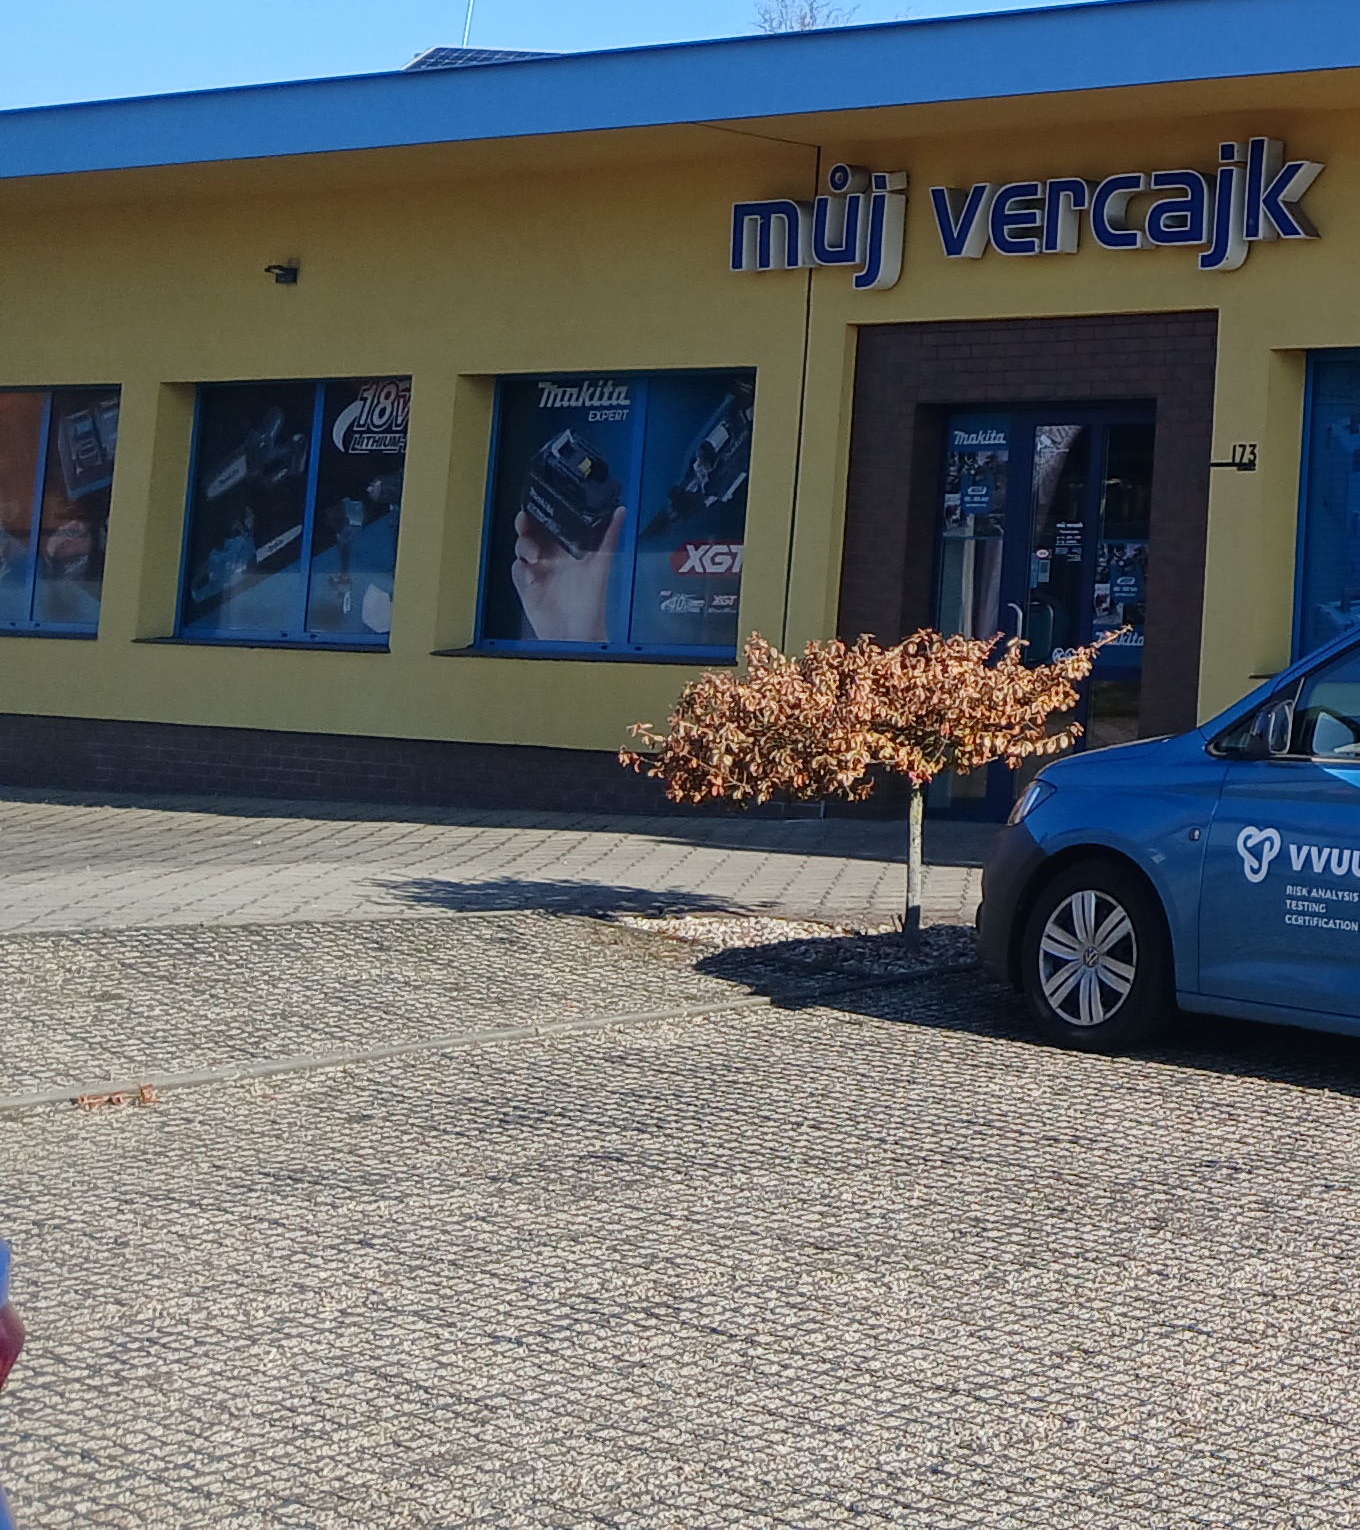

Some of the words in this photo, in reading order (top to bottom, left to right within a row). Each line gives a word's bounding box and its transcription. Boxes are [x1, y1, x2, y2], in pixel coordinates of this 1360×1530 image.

[730, 163, 908, 290] můj
[930, 137, 1324, 270] vercajk
[588, 410, 629, 421] EXPERT
[1232, 444, 1257, 463] 173
[679, 545, 744, 573] XGT
[1286, 885, 1309, 897] RISK
[1310, 887, 1360, 902] ANALYSIS
[1285, 899, 1326, 913] TESTING
[1285, 914, 1359, 932] CERTIFICATION
